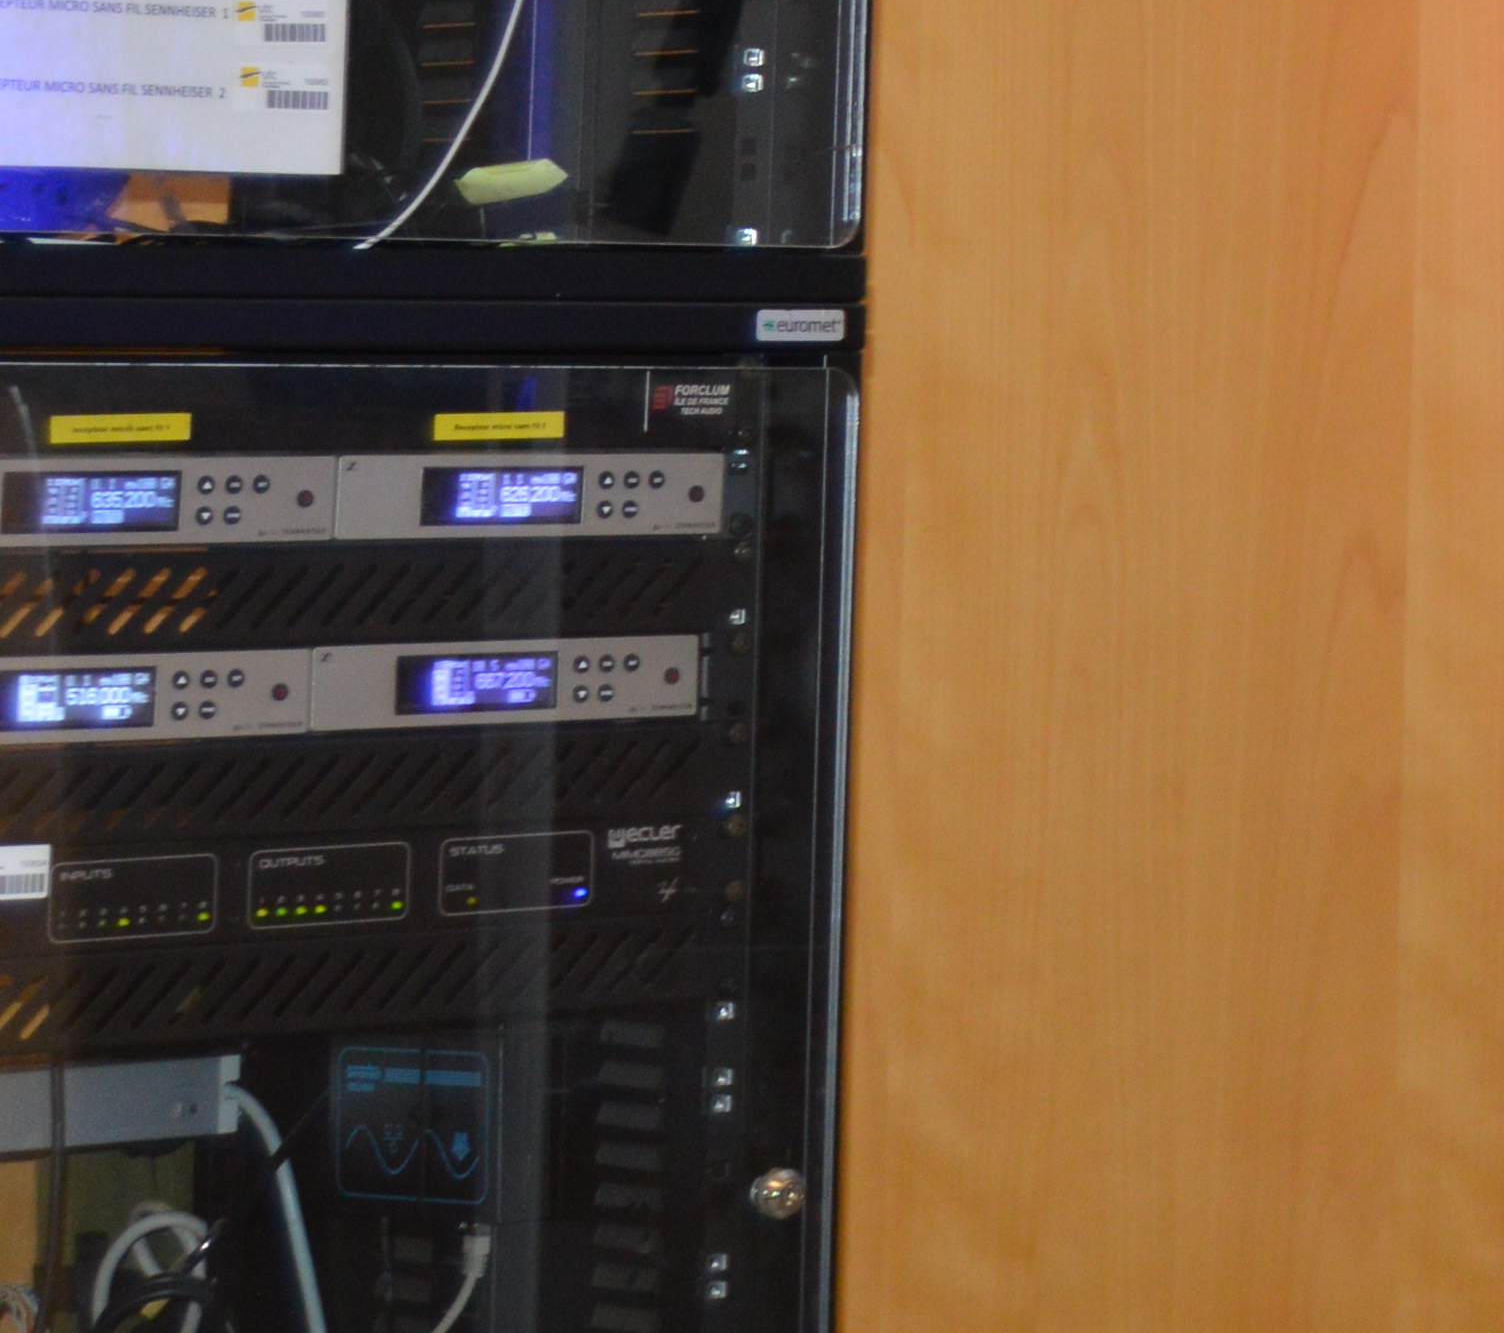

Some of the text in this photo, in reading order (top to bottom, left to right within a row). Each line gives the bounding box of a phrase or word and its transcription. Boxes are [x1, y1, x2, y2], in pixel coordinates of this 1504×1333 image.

[48, 0, 89, 12] MICRO
[92, 1, 123, 14] SANS
[126, 2, 141, 14] FIL
[145, 3, 215, 18] SENNHEISER
[222, 7, 229, 19] 1
[44, 80, 84, 94] MICRO
[88, 82, 119, 95] SANS
[122, 83, 137, 95] FIL
[141, 84, 212, 99] SENNHEISER
[219, 88, 226, 99] 2
[776, 318, 836, 333] euromet
[674, 384, 731, 396] FORCLUM
[450, 844, 504, 857] STATUS
[258, 855, 326, 870] OUTPUTS
[60, 868, 113, 882] INPUTS
